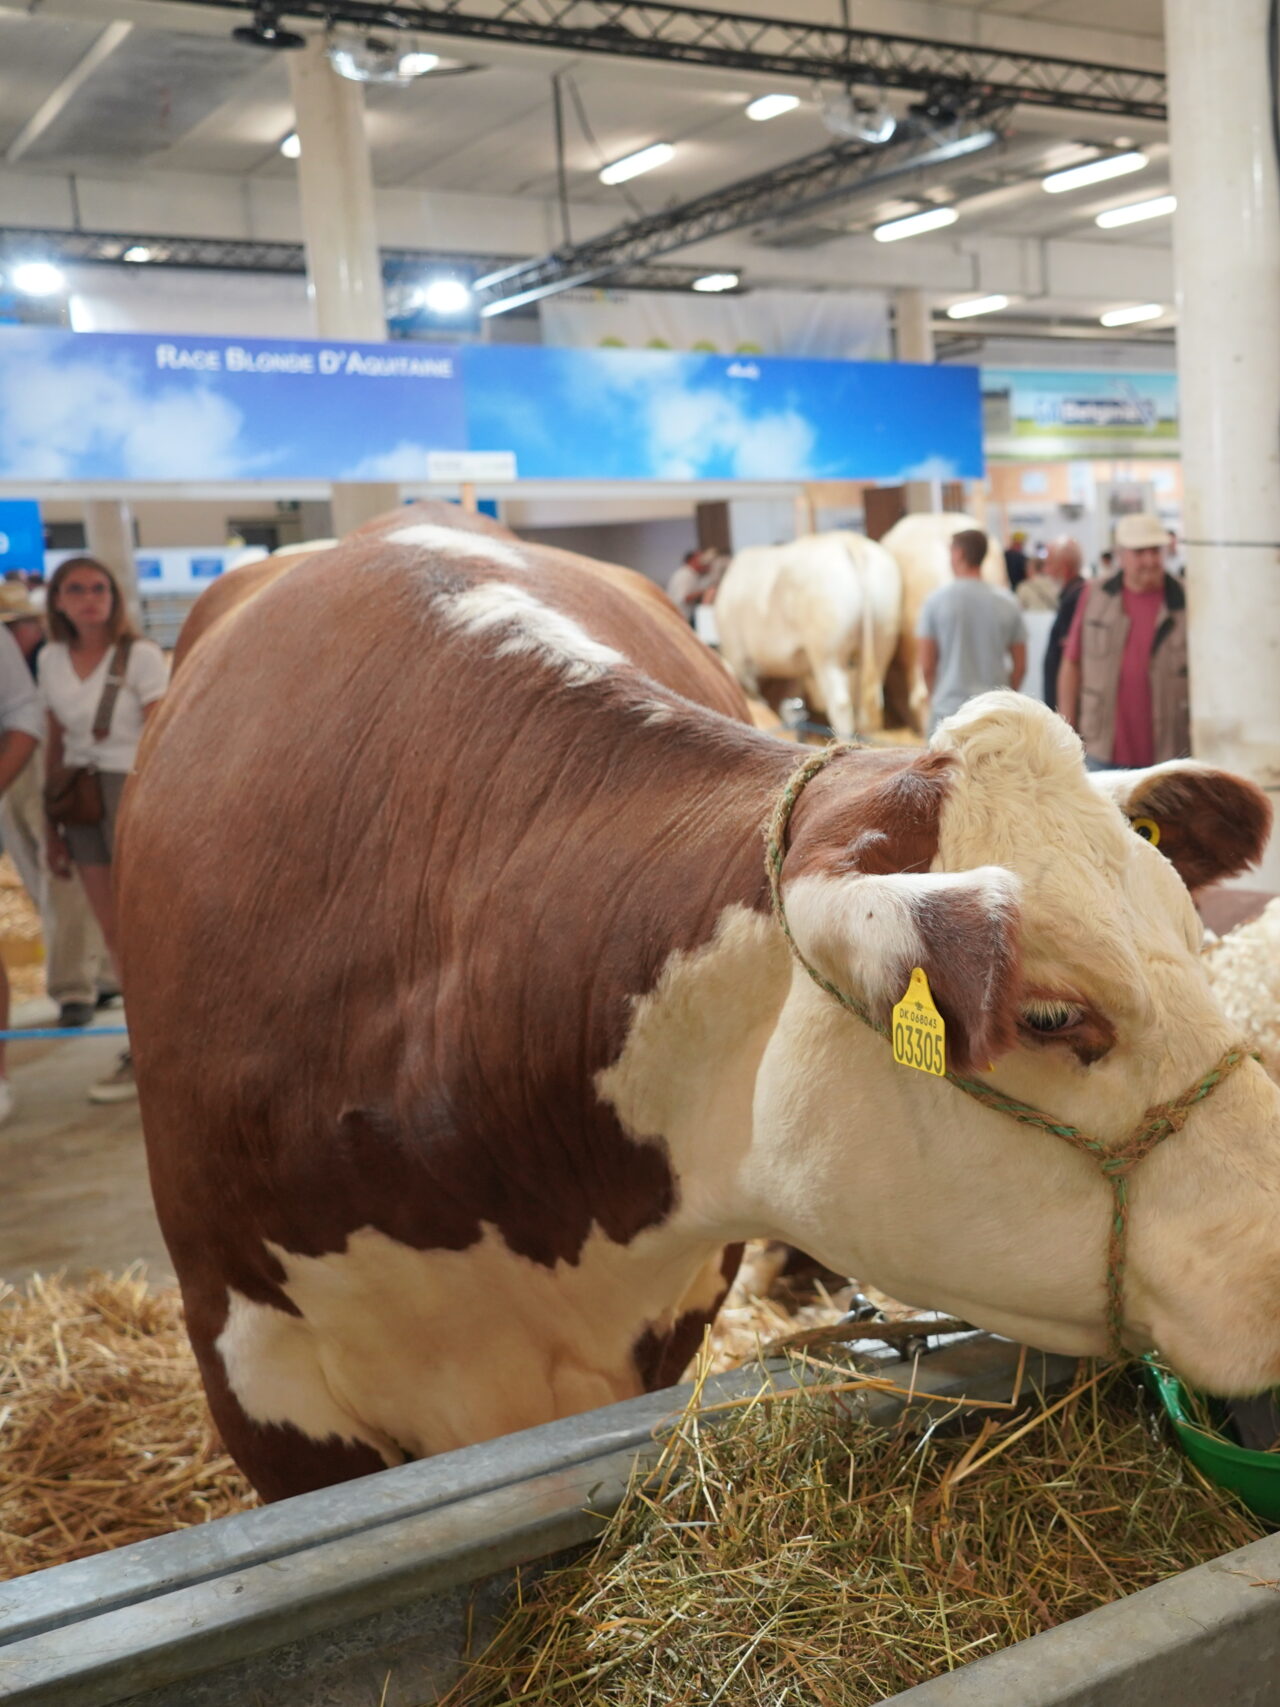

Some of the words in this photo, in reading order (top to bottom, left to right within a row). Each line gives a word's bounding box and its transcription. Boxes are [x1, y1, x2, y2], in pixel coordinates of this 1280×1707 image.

[156, 344, 220, 371] RACE
[225, 346, 314, 374] BLONDE
[318, 349, 454, 379] D'AQUITAINE
[900, 1008, 909, 1020] DK
[895, 1022, 942, 1074] 03305
